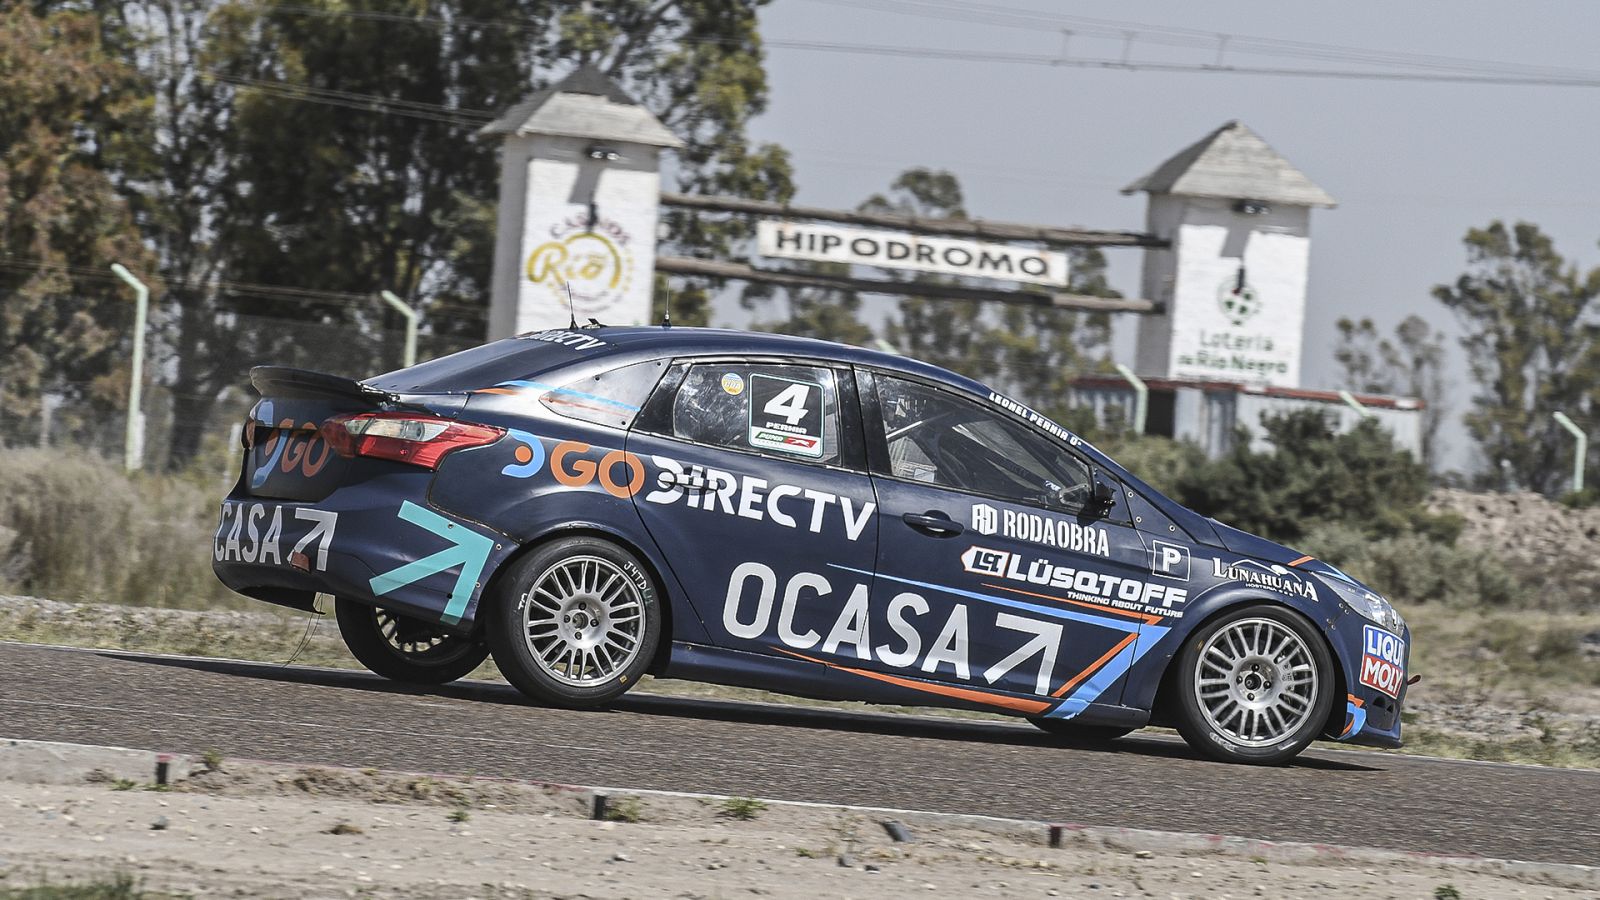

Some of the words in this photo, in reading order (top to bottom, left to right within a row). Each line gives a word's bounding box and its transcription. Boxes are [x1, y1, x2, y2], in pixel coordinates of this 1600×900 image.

[776, 229, 1050, 277] HIPODROMO
[1231, 354, 1288, 376] Negro
[763, 383, 810, 426] 4
[988, 392, 1028, 419] LEONEL
[1028, 413, 1069, 441] PERNIA
[758, 432, 784, 443] PUMA
[765, 421, 807, 434] PERNIA
[645, 454, 877, 542] DIRECTV
[1003, 508, 1110, 558] RODAOBRA
[1006, 553, 1188, 609] LÜSQTOFF
[1162, 547, 1182, 573] P
[1212, 556, 1320, 603] LUNAHUANA
[722, 561, 971, 681] OCASA
[1067, 590, 1110, 605] THINKING
[1111, 598, 1143, 612] ABOUT
[1144, 605, 1184, 619] FUTURE
[1367, 630, 1404, 668] LIQUI
[1363, 659, 1404, 694] MOLY
